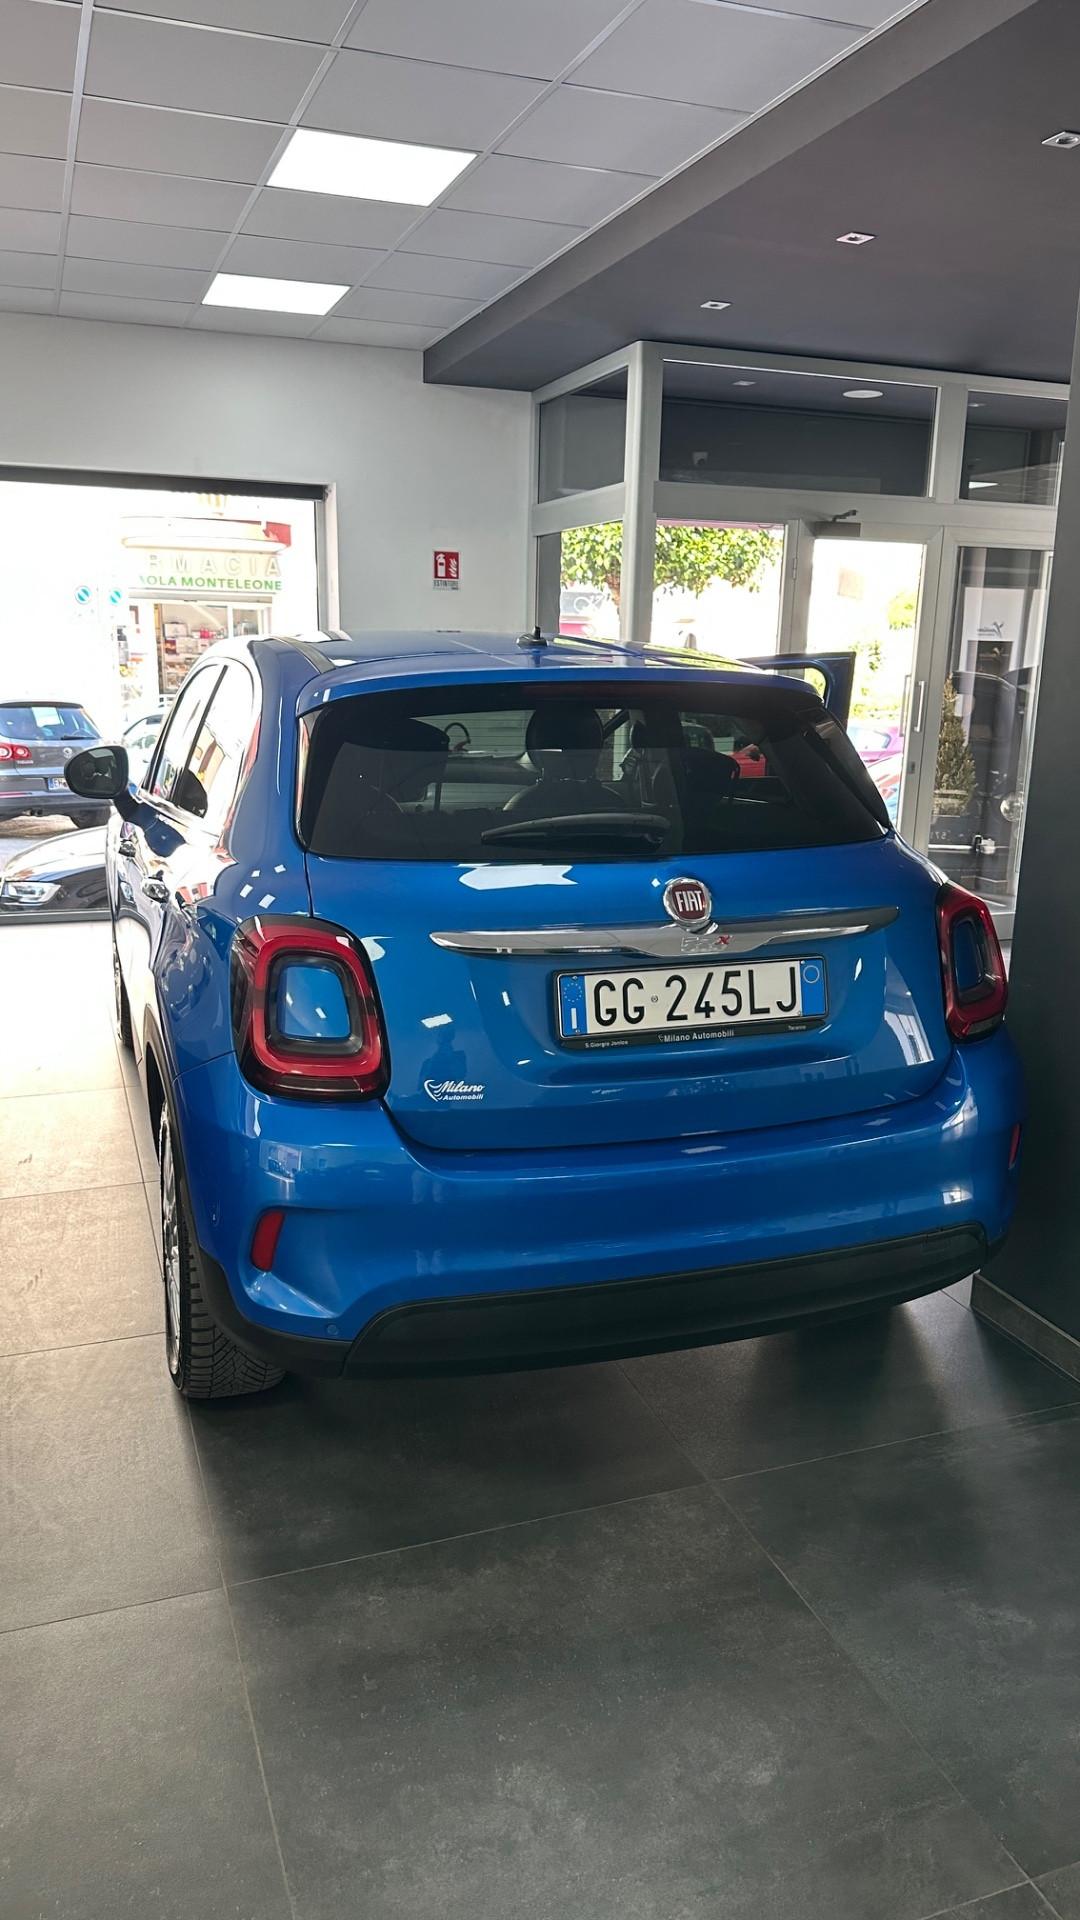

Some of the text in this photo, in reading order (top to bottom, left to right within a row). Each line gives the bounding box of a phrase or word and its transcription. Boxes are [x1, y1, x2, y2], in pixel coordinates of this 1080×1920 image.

[181, 576, 282, 591] MONTELEONE
[674, 890, 703, 912] FIAT
[594, 966, 796, 1027] GG 245LJ
[664, 1029, 735, 1043] Milano Automobili
[440, 1080, 486, 1093] Milano
[442, 1093, 484, 1101] Automobili
